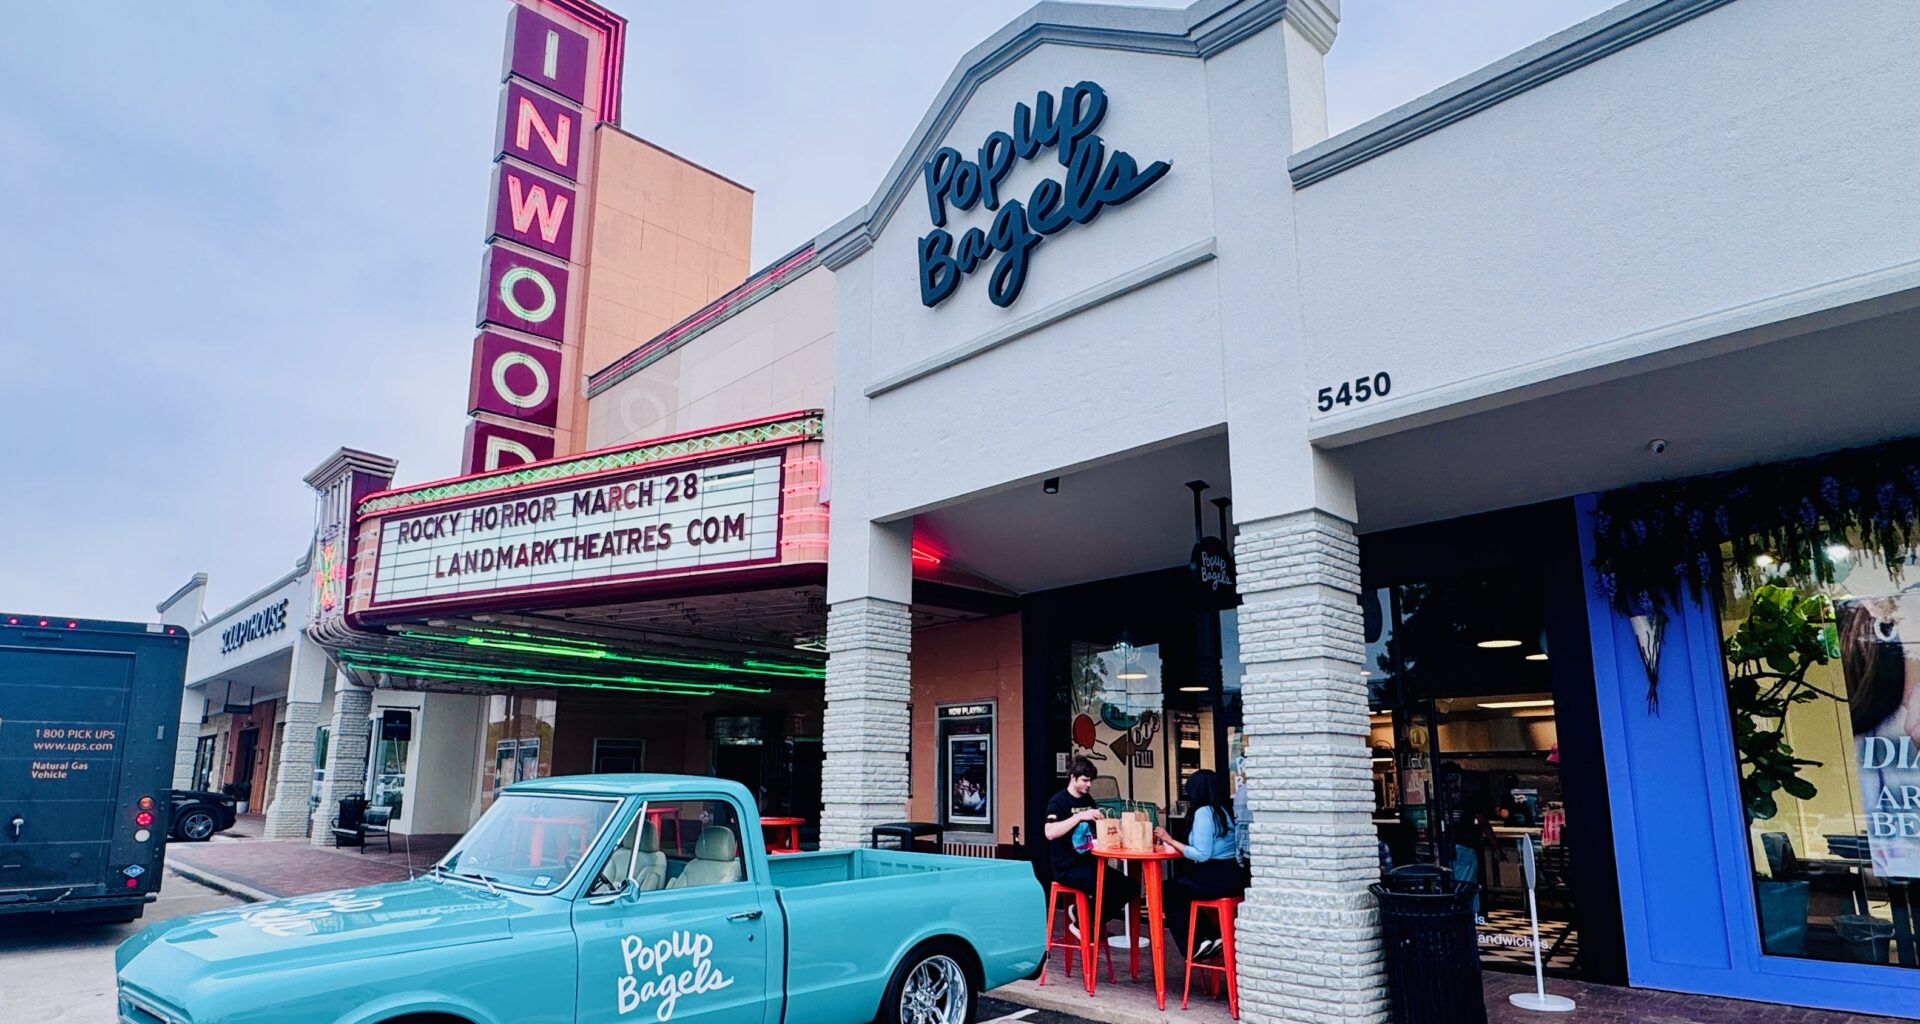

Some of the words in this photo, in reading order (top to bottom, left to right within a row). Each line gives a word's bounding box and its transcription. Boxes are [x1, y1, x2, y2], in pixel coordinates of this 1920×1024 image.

[918, 134, 1172, 308] Bagels
[1318, 371, 1391, 412] 5450
[398, 511, 461, 546] ROCKY
[471, 496, 557, 533] HORROR
[572, 480, 653, 518] MARCH
[665, 472, 698, 502] 28
[435, 524, 672, 579] LANDMARKTHEATRES
[687, 512, 746, 544] COM
[1201, 567, 1233, 590] Bagels
[948, 707, 962, 716] NOW
[962, 706, 988, 715] PLAYING
[35, 729, 41, 738] 1
[43, 729, 65, 739] 800
[67, 729, 92, 739] PICK
[95, 729, 115, 740] UPS
[33, 742, 113, 752] www.ups.com
[1862, 736, 1920, 769] DI
[31, 770, 67, 779] Vehicle
[32, 761, 68, 770] Natural
[71, 761, 88, 770] Gas
[1477, 933, 1552, 950] andwichs.
[618, 958, 735, 1022] Bagels
